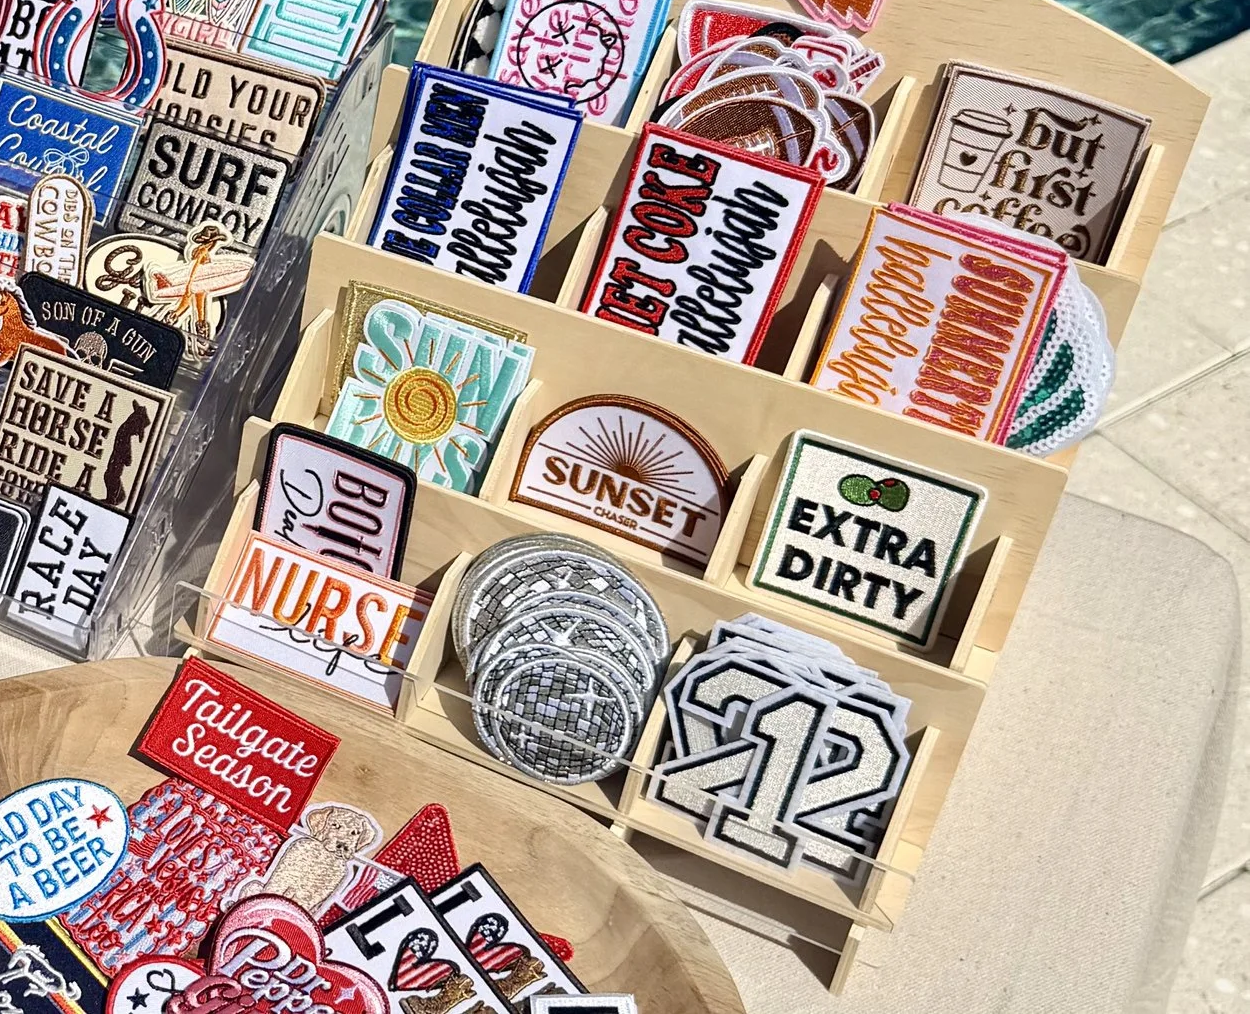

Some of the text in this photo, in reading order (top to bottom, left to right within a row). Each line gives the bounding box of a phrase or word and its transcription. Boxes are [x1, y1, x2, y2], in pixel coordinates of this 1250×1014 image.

[8, 94, 120, 154] Coastal
[229, 74, 312, 128] YOUR
[1015, 106, 1106, 170] but
[63, 189, 79, 225] DIBS
[148, 134, 278, 208] SURF
[390, 141, 474, 236] COLLAR
[446, 119, 558, 286] allelujah
[988, 149, 1097, 217] first
[32, 186, 61, 277] COWBO
[60, 227, 75, 249] ON
[594, 142, 722, 337] IET COKE
[669, 181, 790, 356] allelujah
[41, 301, 157, 364] SON OF A GUN
[825, 235, 954, 407] halleluja
[902, 252, 1036, 438] SUMMERTI
[20, 360, 119, 424] SAVE A
[358, 308, 521, 438] SUN
[5, 392, 111, 460] HORSE
[73, 463, 98, 499] A
[541, 455, 707, 539] SUNSET
[592, 505, 638, 532] CHASER
[18, 495, 90, 621] RACE
[786, 496, 938, 579] EXTRA
[62, 537, 113, 617] DAY
[233, 547, 424, 669] NURSE
[774, 544, 925, 621] DIRTY
[180, 678, 319, 778] Tailgate
[171, 722, 293, 814] Season
[26, 785, 85, 828] DAY
[42, 816, 88, 856] BE
[8, 836, 115, 911] A BEER
[273, 953, 332, 996] Dr
